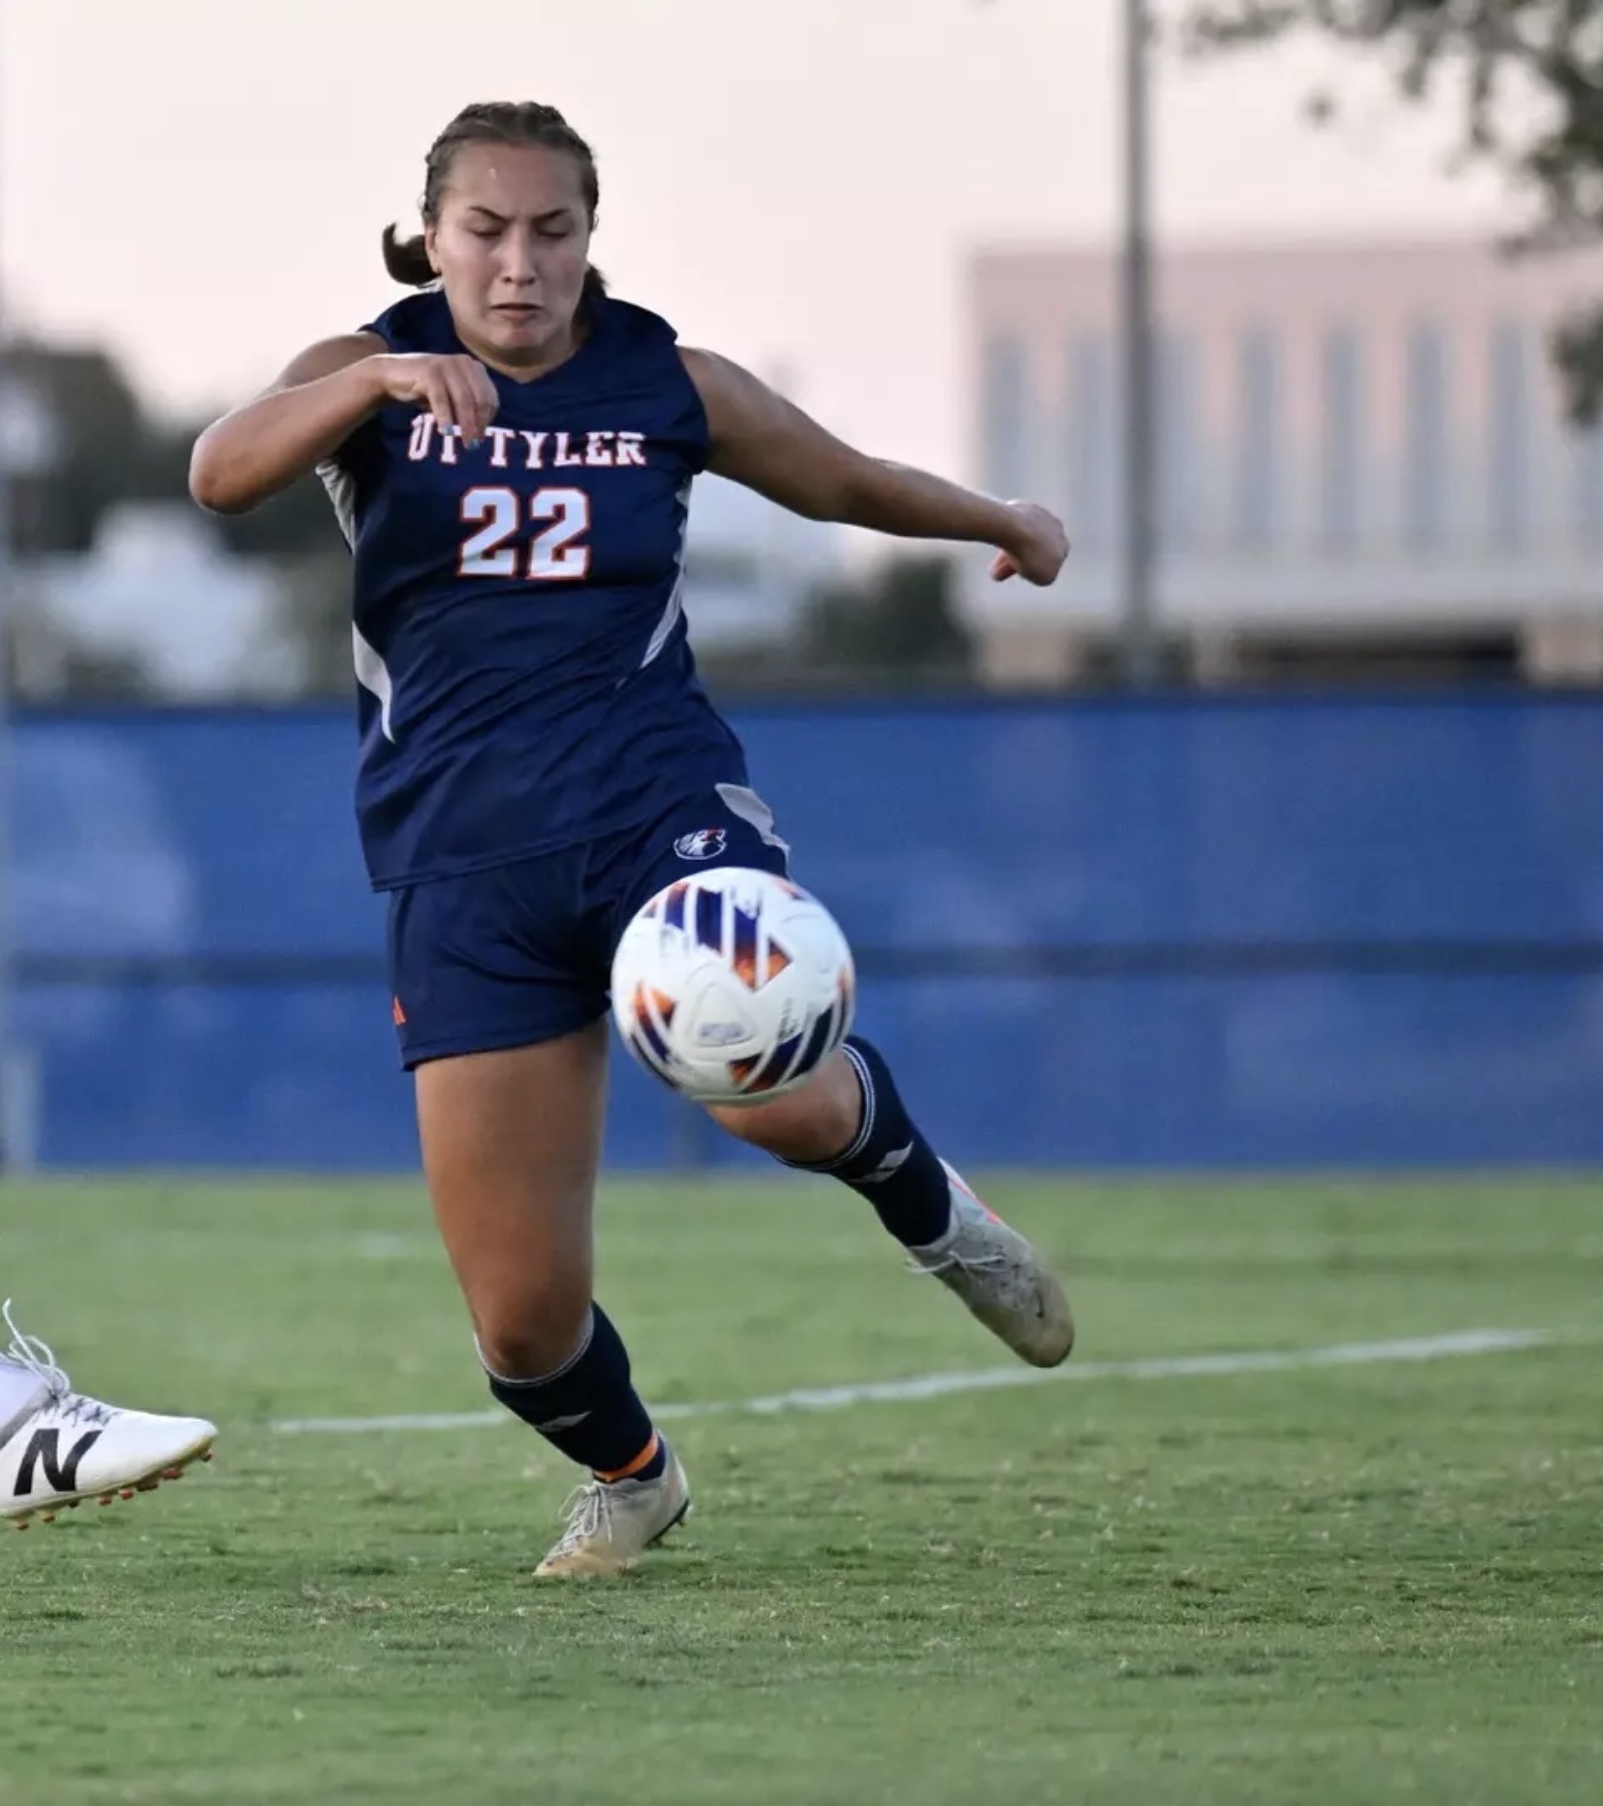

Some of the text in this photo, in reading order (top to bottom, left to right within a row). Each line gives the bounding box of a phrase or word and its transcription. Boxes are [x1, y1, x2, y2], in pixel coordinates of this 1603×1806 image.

[484, 425, 647, 470] TYLER
[457, 485, 591, 580] 22
[13, 1428, 104, 1497] N
